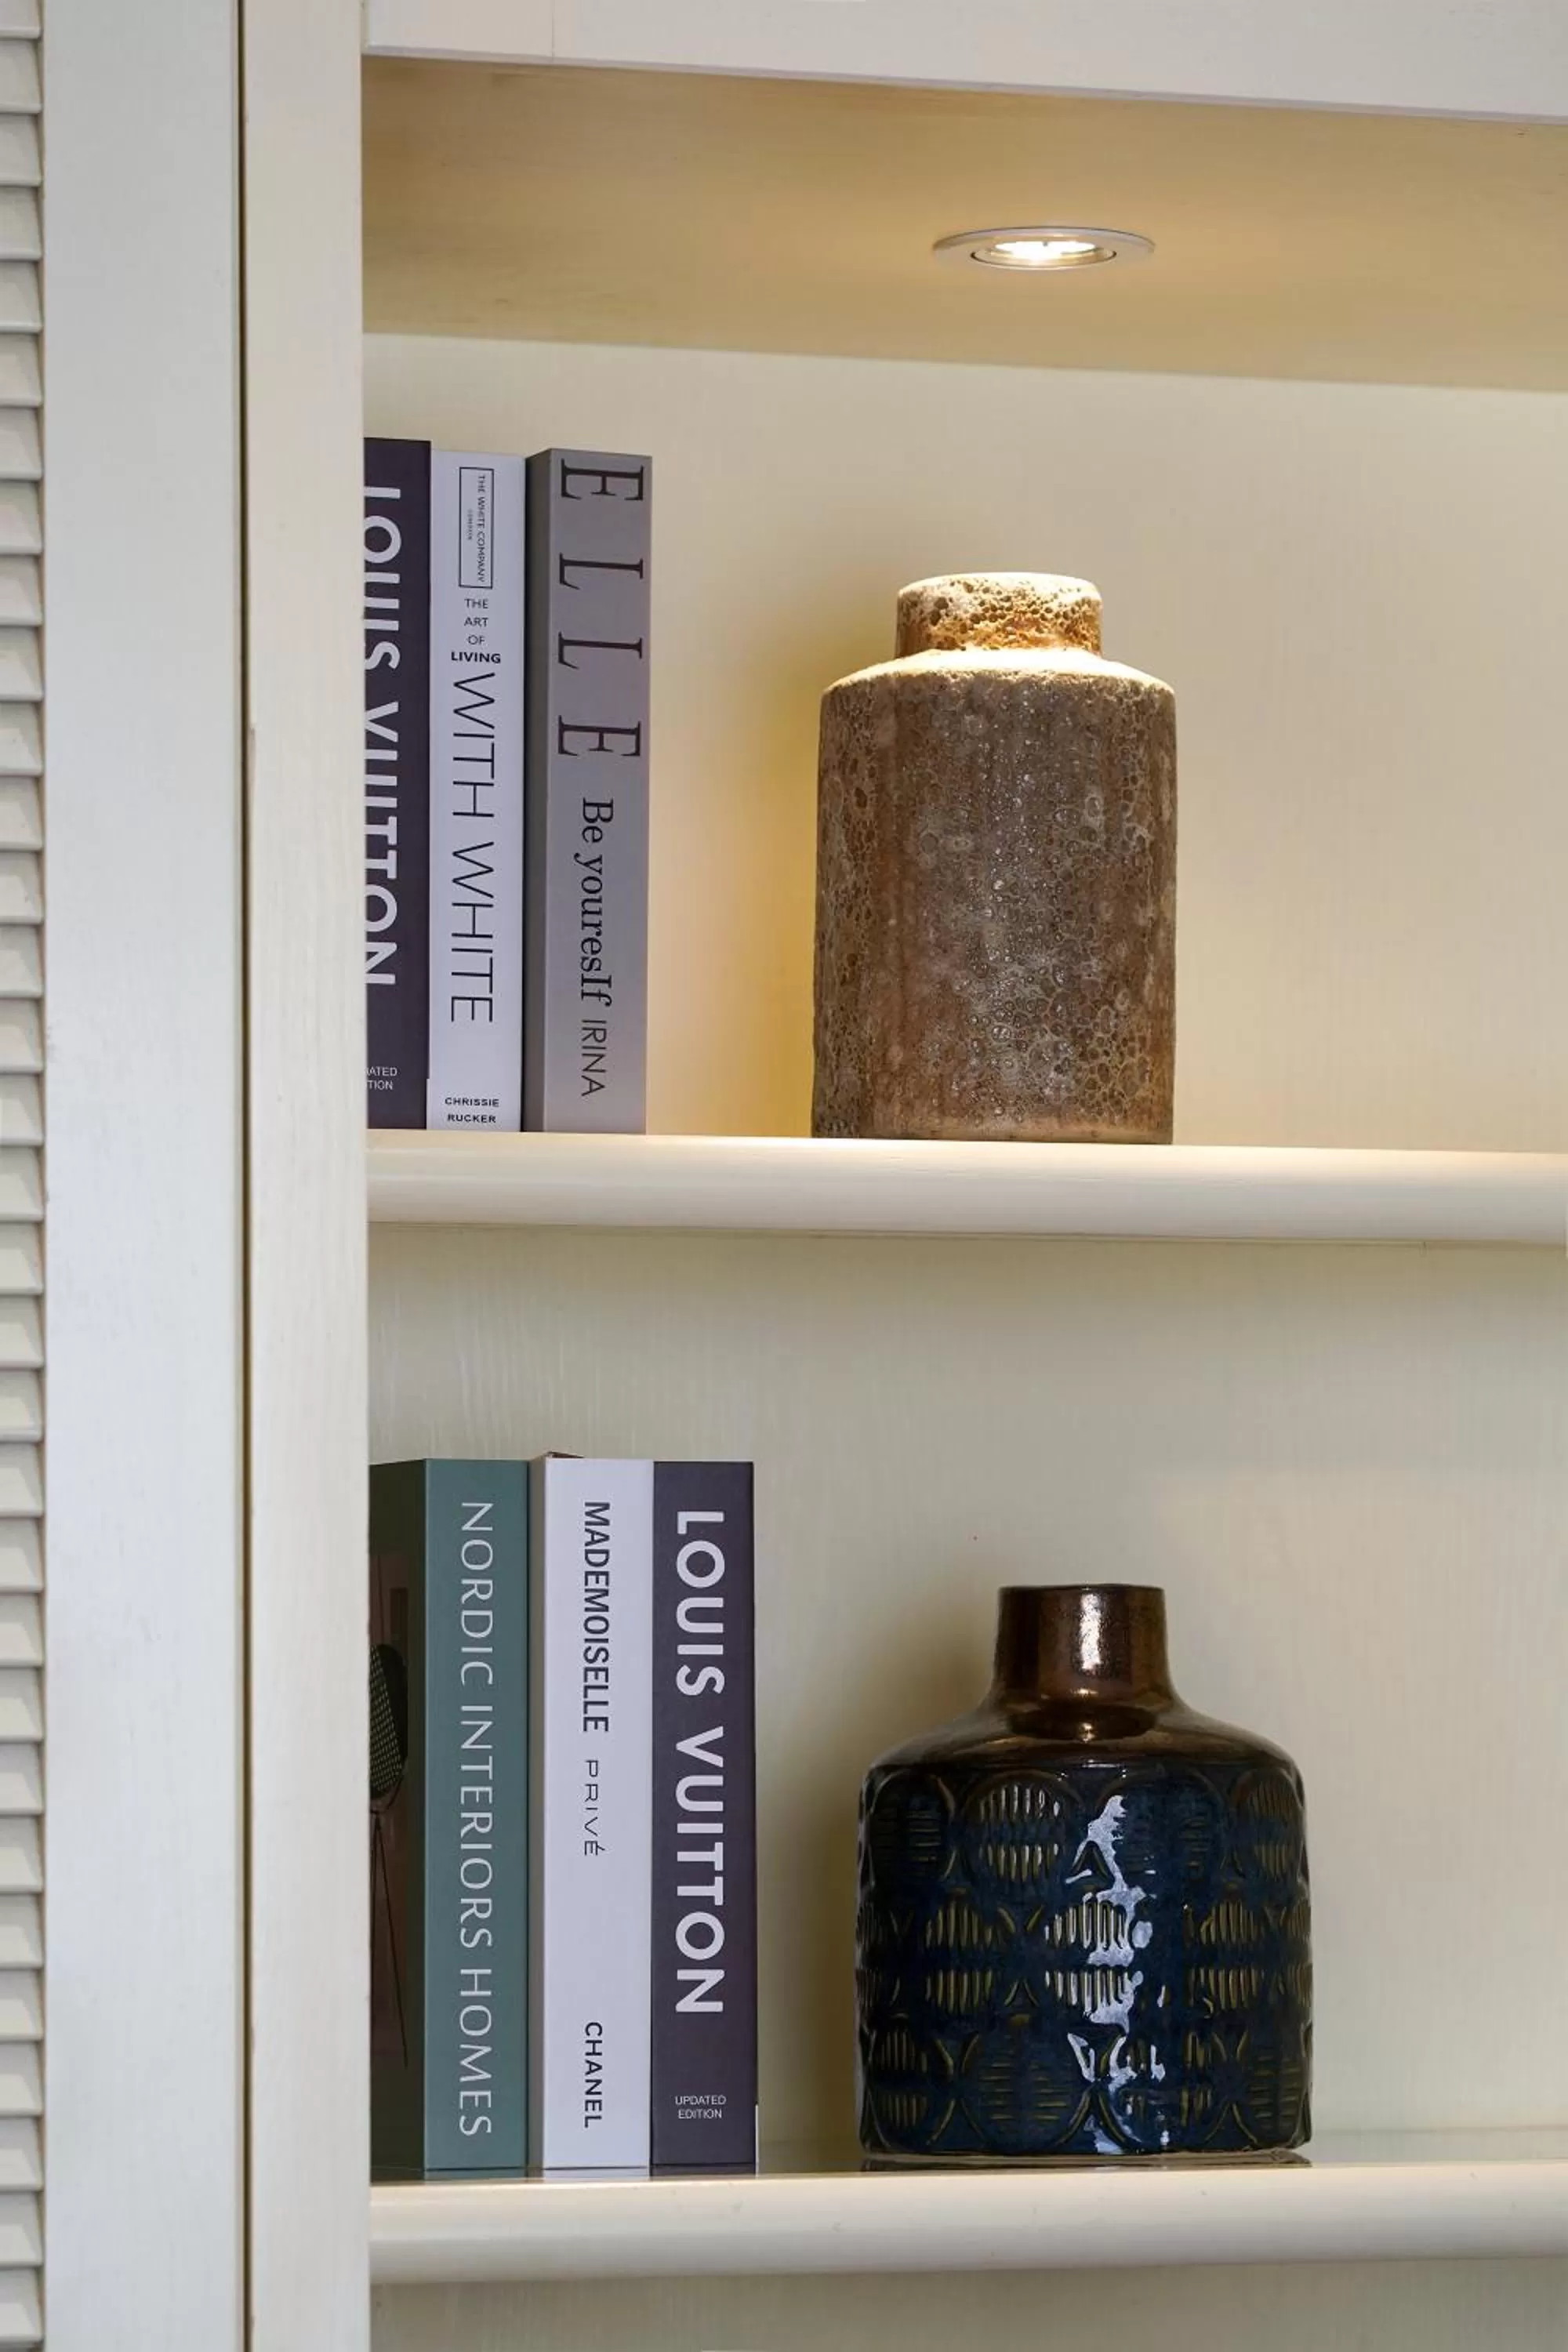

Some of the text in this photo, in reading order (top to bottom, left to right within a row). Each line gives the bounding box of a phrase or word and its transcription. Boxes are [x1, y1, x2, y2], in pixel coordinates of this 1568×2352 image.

[476, 474, 486, 583] THE WHITE COMPANY
[463, 597, 488, 609] THE
[463, 616, 488, 628] ART
[558, 459, 644, 757] ELLE
[451, 652, 501, 664] LIVING
[467, 634, 485, 645] OF
[582, 798, 613, 843] Be
[451, 672, 496, 1023] WITH WHITE
[582, 1020, 607, 1096] IRINA
[368, 1080, 394, 1091] TION
[445, 1097, 499, 1108] CHRISSIE
[447, 1113, 496, 1123] RUCKER
[583, 1502, 610, 1732] MADEMOISELLE
[676, 1512, 724, 2012] LOUIS VUITTON
[459, 1503, 493, 2136] NORDIC INTERIORS HOMES
[585, 1760, 605, 1856] PRIVÉ
[585, 2022, 602, 2128] CHANEL
[674, 2094, 727, 2106] UPDATED
[677, 2108, 722, 2119] EDITION
